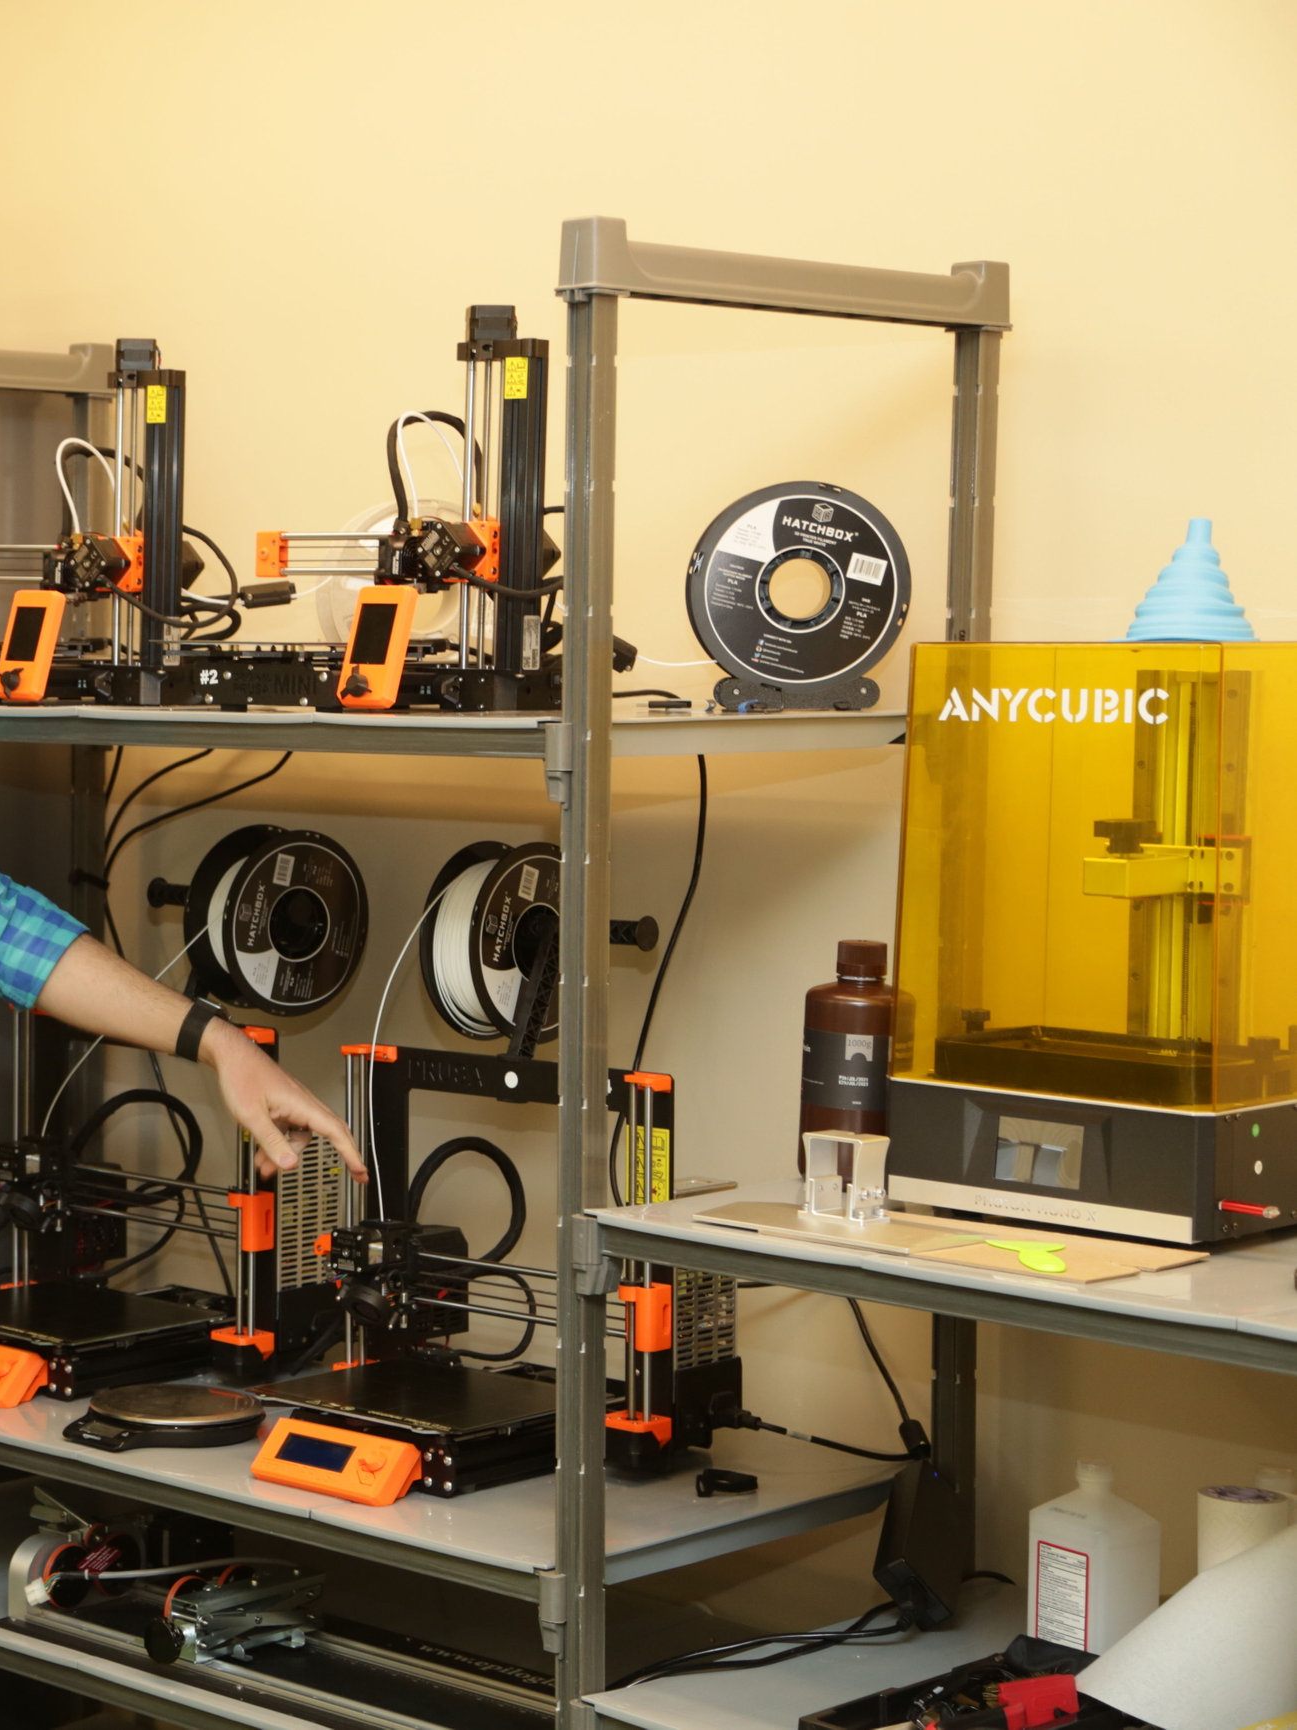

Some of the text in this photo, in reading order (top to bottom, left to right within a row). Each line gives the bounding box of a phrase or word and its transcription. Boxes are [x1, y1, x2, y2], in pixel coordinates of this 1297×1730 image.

[782, 515, 854, 543] HATCHBOX
[727, 578, 738, 586] PLA
[856, 610, 868, 619] PLA
[199, 668, 219, 685] #2
[273, 672, 317, 696] MINI
[938, 686, 1170, 725] ANYCUBIC
[247, 883, 266, 948] HATCHBOX
[492, 896, 511, 963] HATCHBOX
[847, 1039, 872, 1050] 1000g
[407, 1059, 484, 1088] PRUSA
[1086, 1209, 1098, 1223] X
